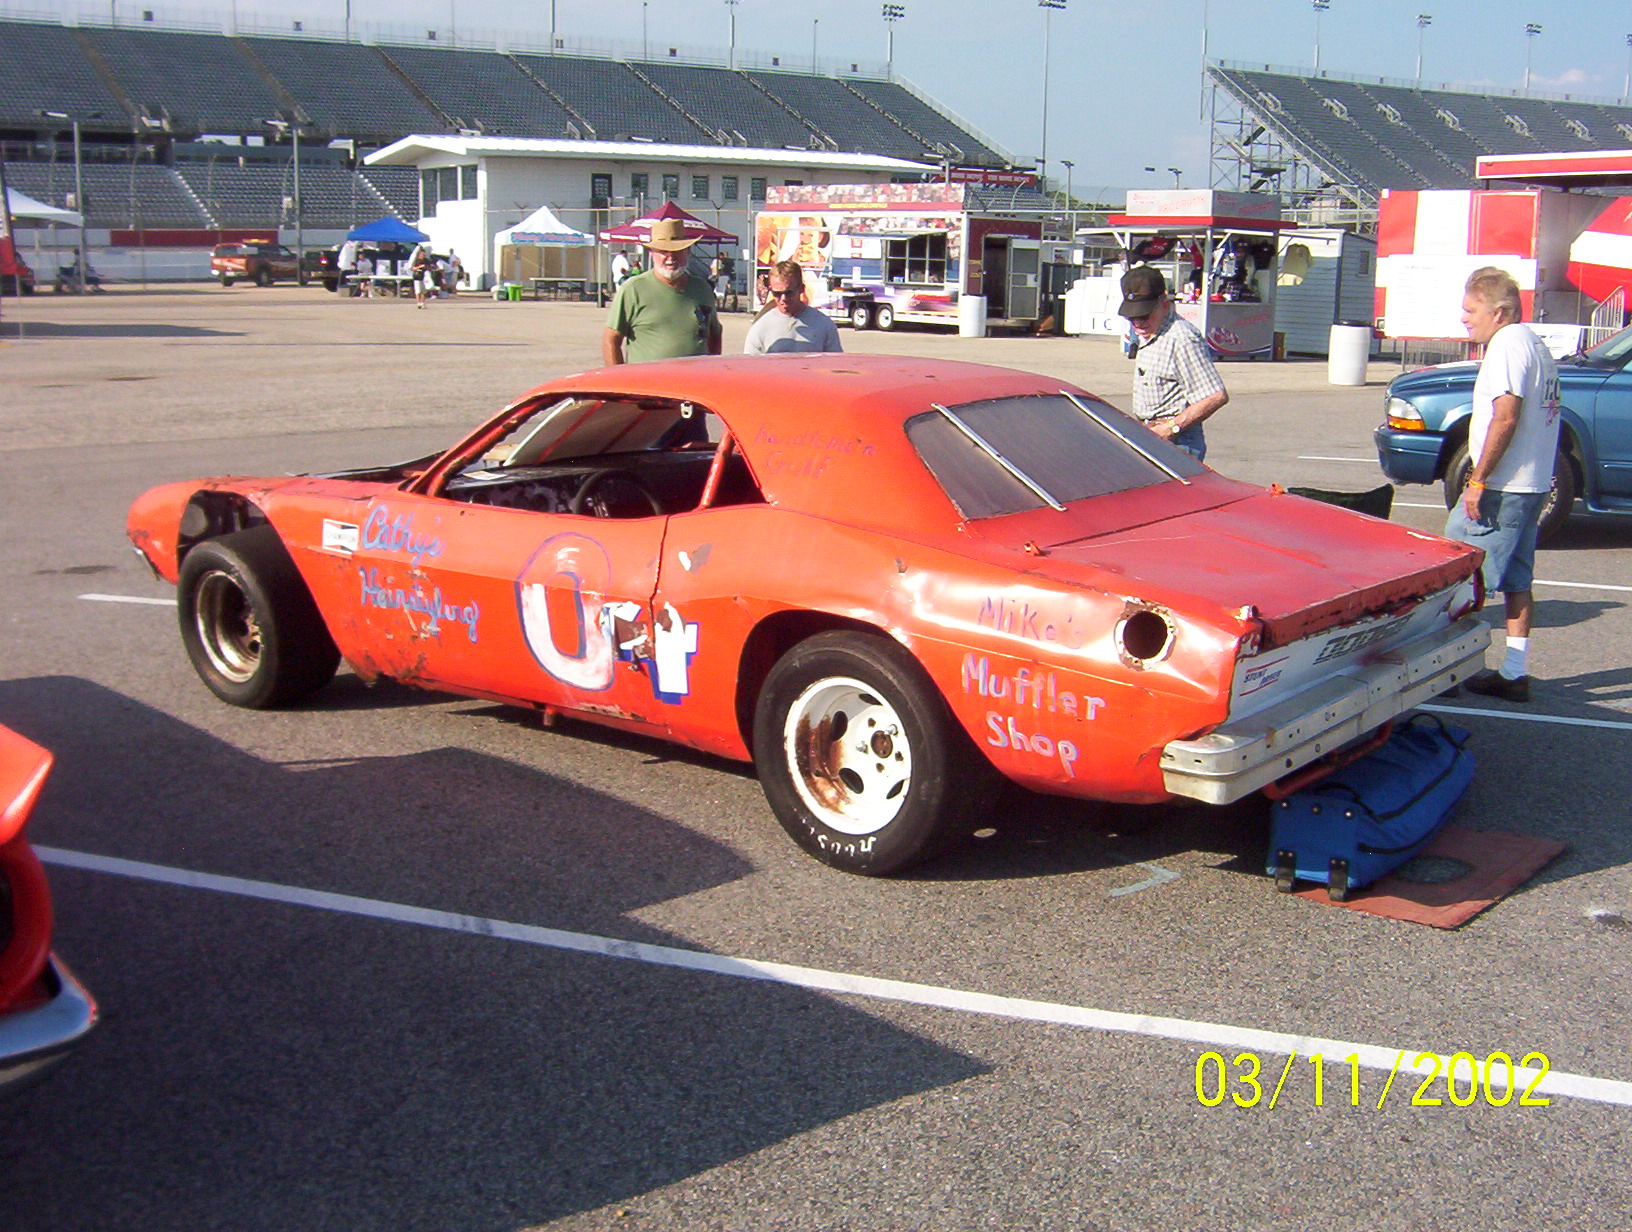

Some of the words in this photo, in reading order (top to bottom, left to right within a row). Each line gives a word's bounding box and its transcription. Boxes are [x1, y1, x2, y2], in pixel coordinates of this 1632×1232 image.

[361, 504, 445, 565] Cathy's
[961, 652, 1106, 720] Muffler
[985, 710, 1080, 778] Shop
